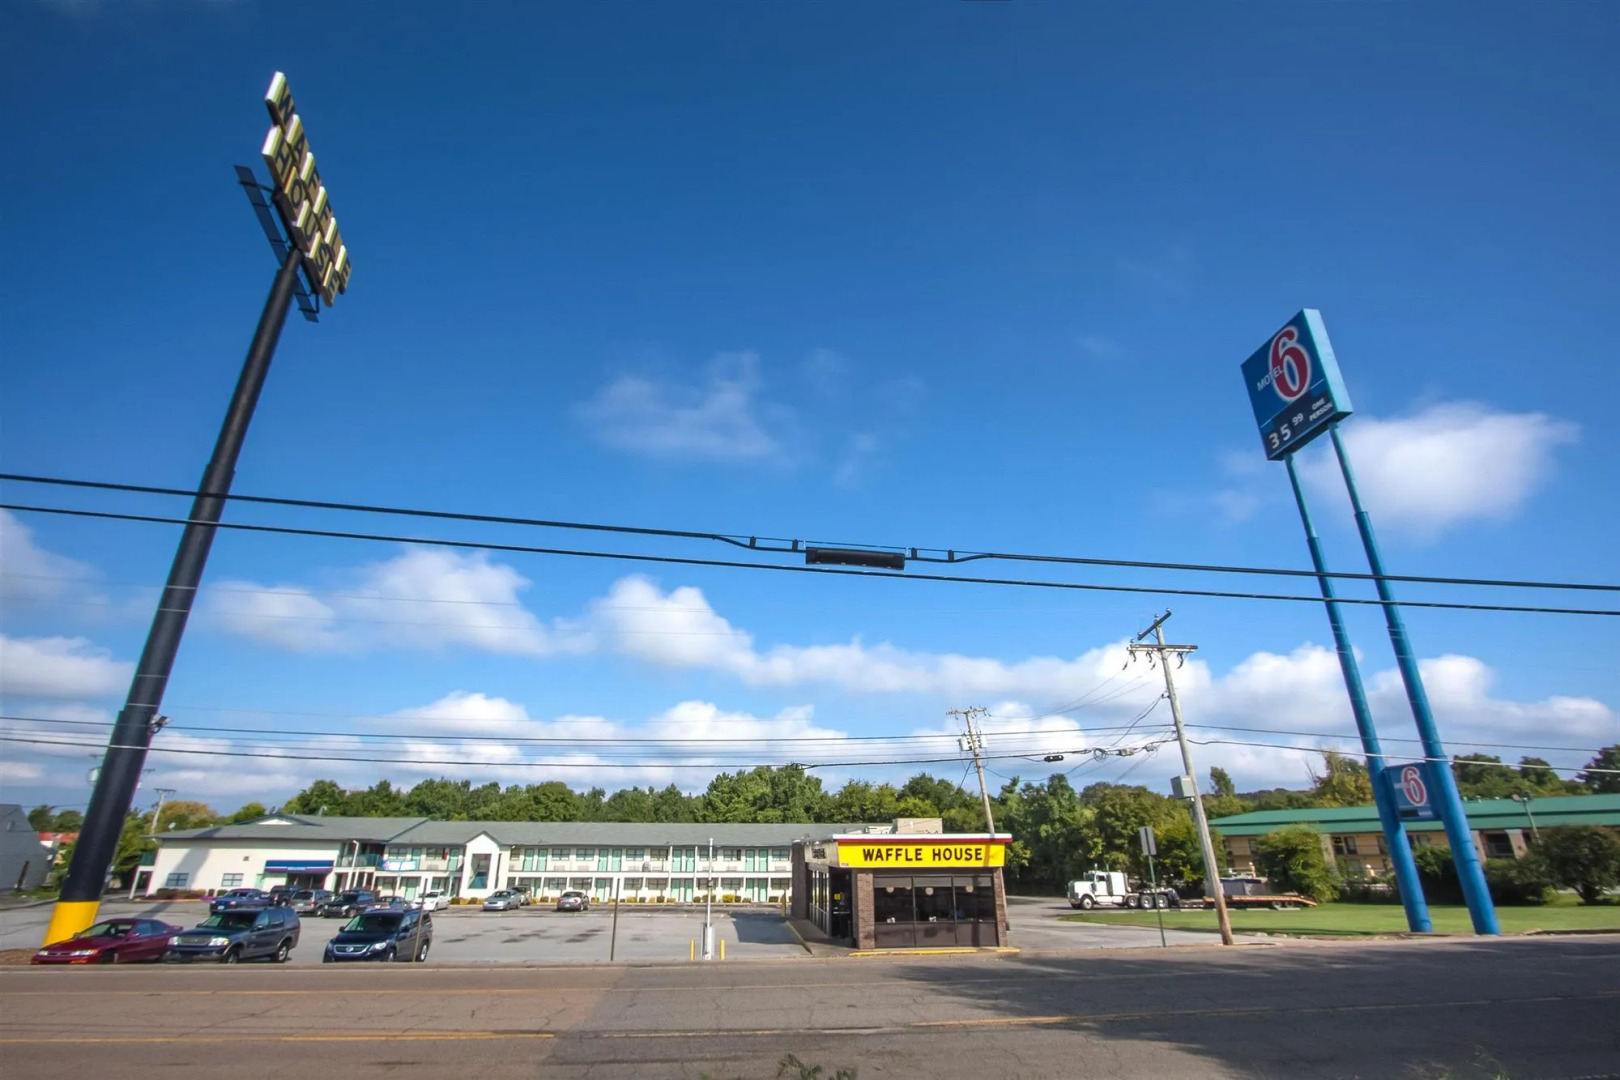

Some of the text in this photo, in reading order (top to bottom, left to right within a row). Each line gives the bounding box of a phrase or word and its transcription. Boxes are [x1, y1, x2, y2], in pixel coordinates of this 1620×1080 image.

[275, 135, 340, 298] HOUSE
[278, 83, 351, 285] WAFFLE
[1256, 325, 1311, 402] MOTEL 6
[1401, 766, 1427, 806] 6
[862, 848, 983, 862] WAFFLE HOUSE
